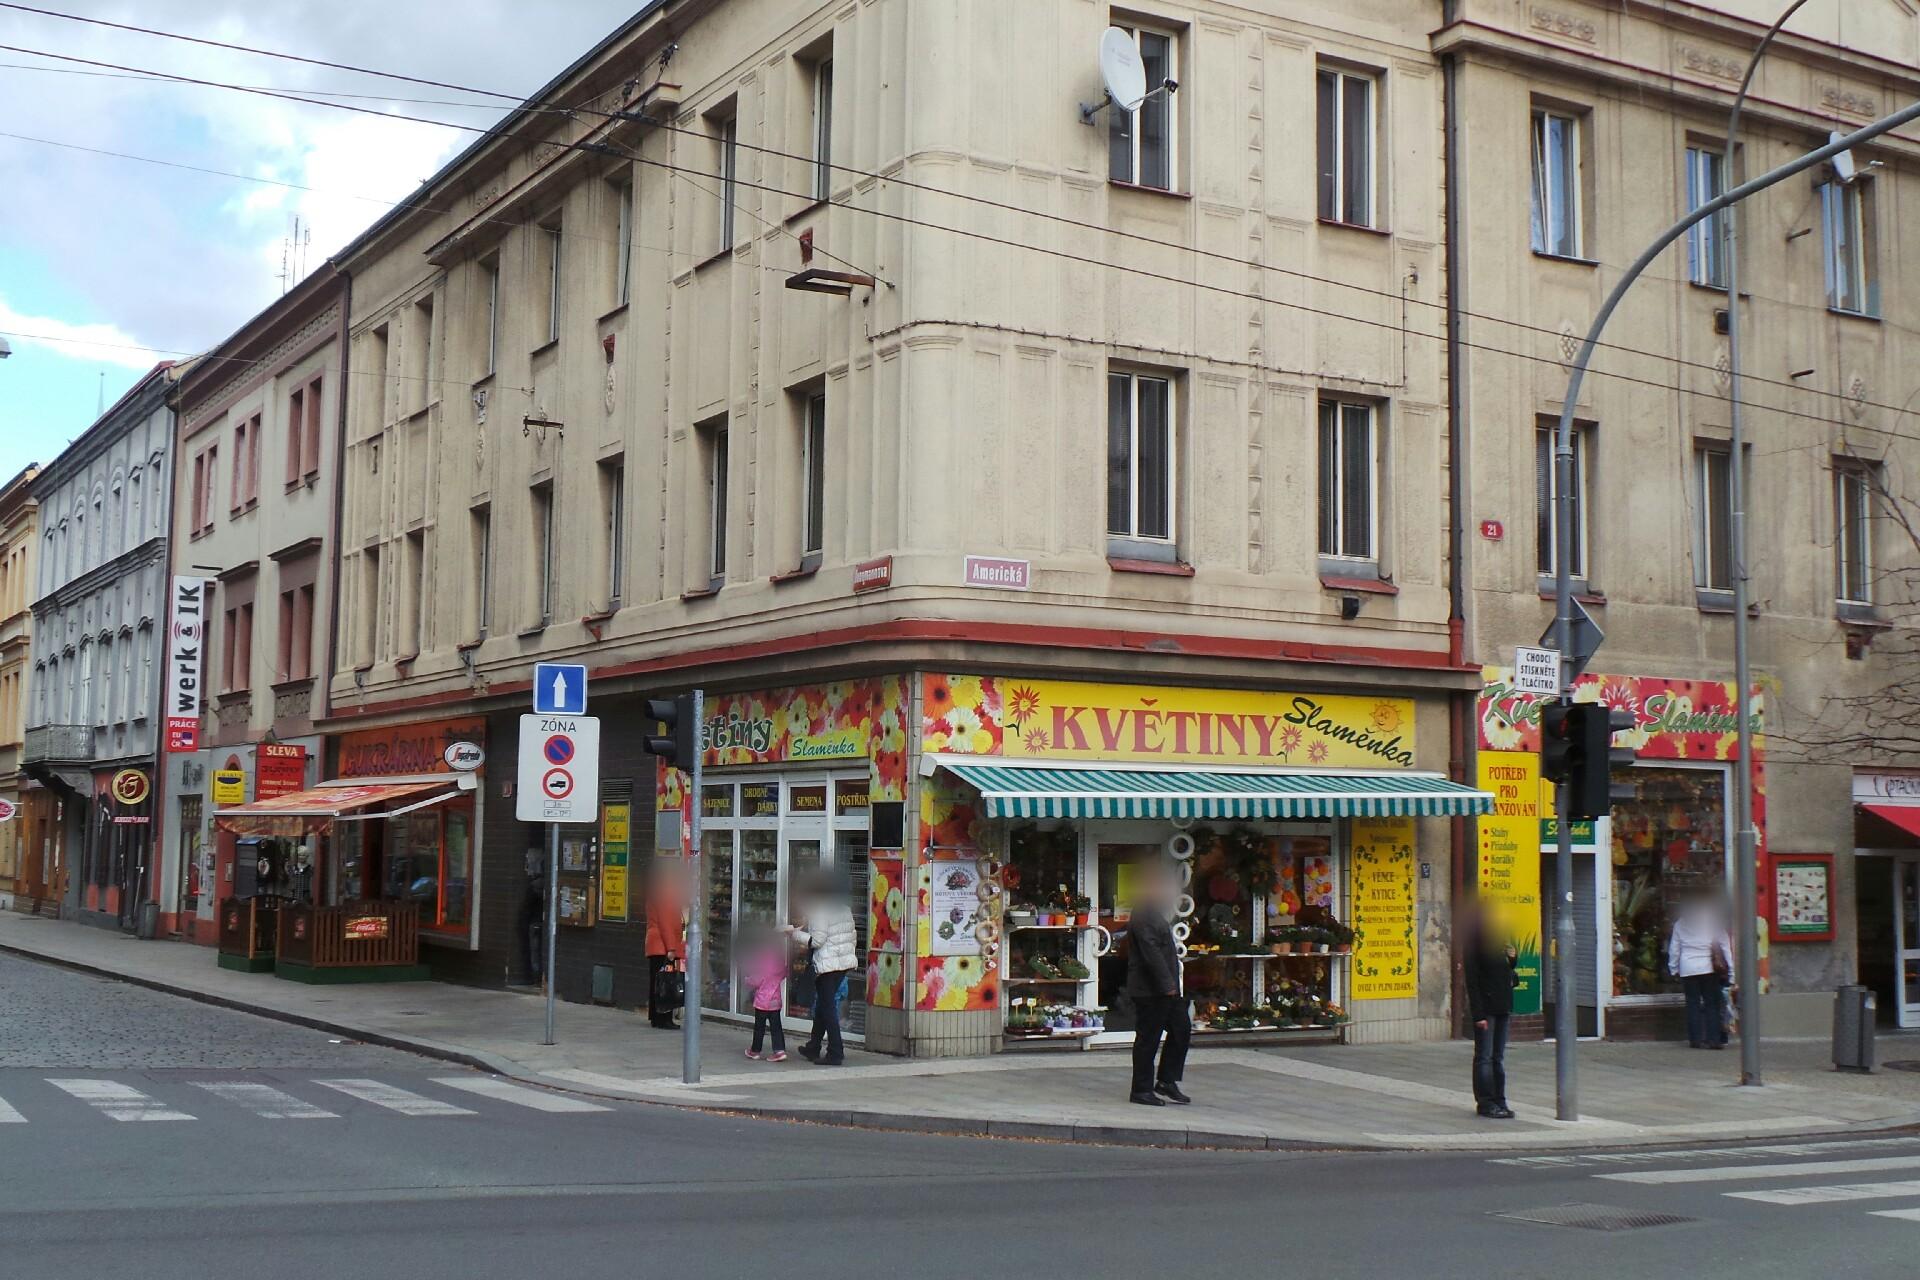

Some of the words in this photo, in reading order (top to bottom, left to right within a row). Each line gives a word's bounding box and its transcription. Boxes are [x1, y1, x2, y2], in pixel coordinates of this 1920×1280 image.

[1487, 524, 1497, 536] 21
[972, 562, 1022, 583] Americká
[182, 626, 193, 637] &
[1526, 652, 1551, 664] CHODCI
[1520, 664, 1556, 678] STISKNĚTE
[175, 647, 198, 713] werk
[1521, 676, 1554, 690] TLAČÍTKO
[1642, 694, 1761, 733] Slaměna
[169, 720, 197, 729] PRÁCE
[541, 718, 577, 733] ZÓNA
[1050, 697, 1283, 756] KVĚTINY
[1283, 696, 1414, 768] Slaměnka
[266, 745, 299, 757] SLEVA
[792, 736, 856, 757] Slaměnka
[1488, 764, 1528, 781] POTŘEBY
[1500, 785, 1518, 799] PRO
[796, 796, 823, 807] SEMENA
[1371, 888, 1396, 900] KYTICE
